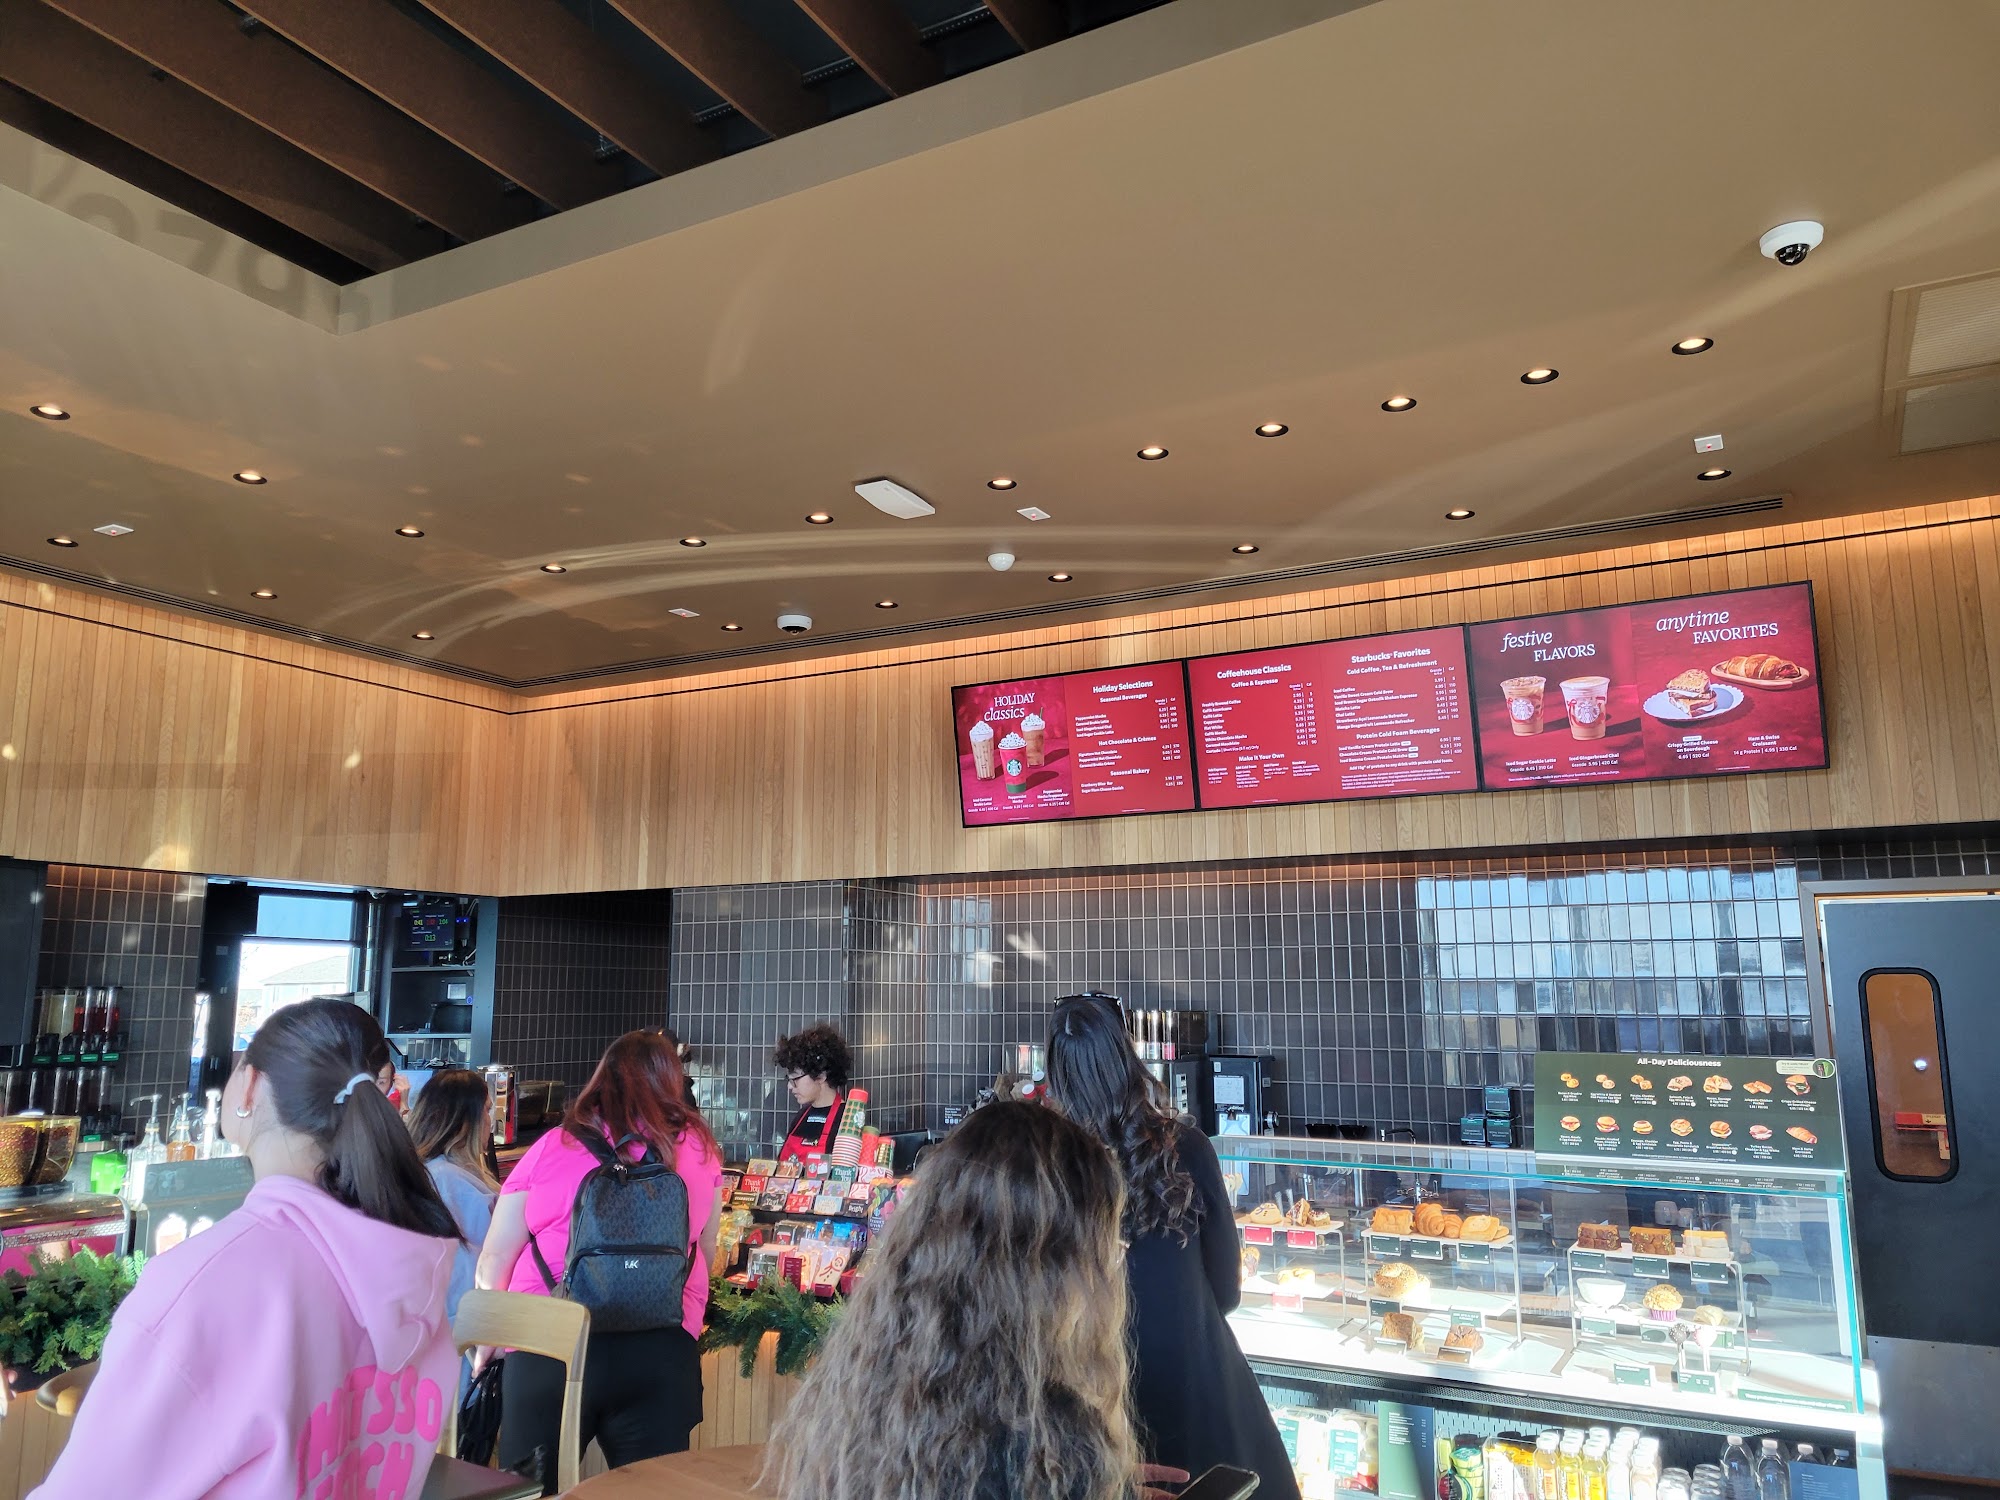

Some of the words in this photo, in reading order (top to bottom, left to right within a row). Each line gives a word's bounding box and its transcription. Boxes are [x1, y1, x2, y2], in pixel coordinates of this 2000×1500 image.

[1656, 611, 1729, 632] anytime
[1693, 623, 1778, 644] FAVORITES
[1500, 631, 1552, 652] festive
[1394, 648, 1430, 658] Favorites
[1534, 644, 1595, 661] FLAVORS
[1399, 660, 1437, 669] Refreshment
[1217, 667, 1262, 679] Coffeehouse
[1263, 664, 1291, 673] Classics
[1093, 684, 1118, 693] Holiday
[1119, 680, 1153, 690] Selections
[1255, 679, 1278, 687] Espresso
[994, 693, 1035, 707] HOLIDAY
[984, 706, 1024, 721] classics
[1410, 727, 1440, 735] Beverages
[1637, 1058, 1666, 1067] All-Day
[1668, 1058, 1721, 1067] Deliciousness
[835, 1167, 852, 1176] Thank
[624, 1259, 638, 1269] MK
